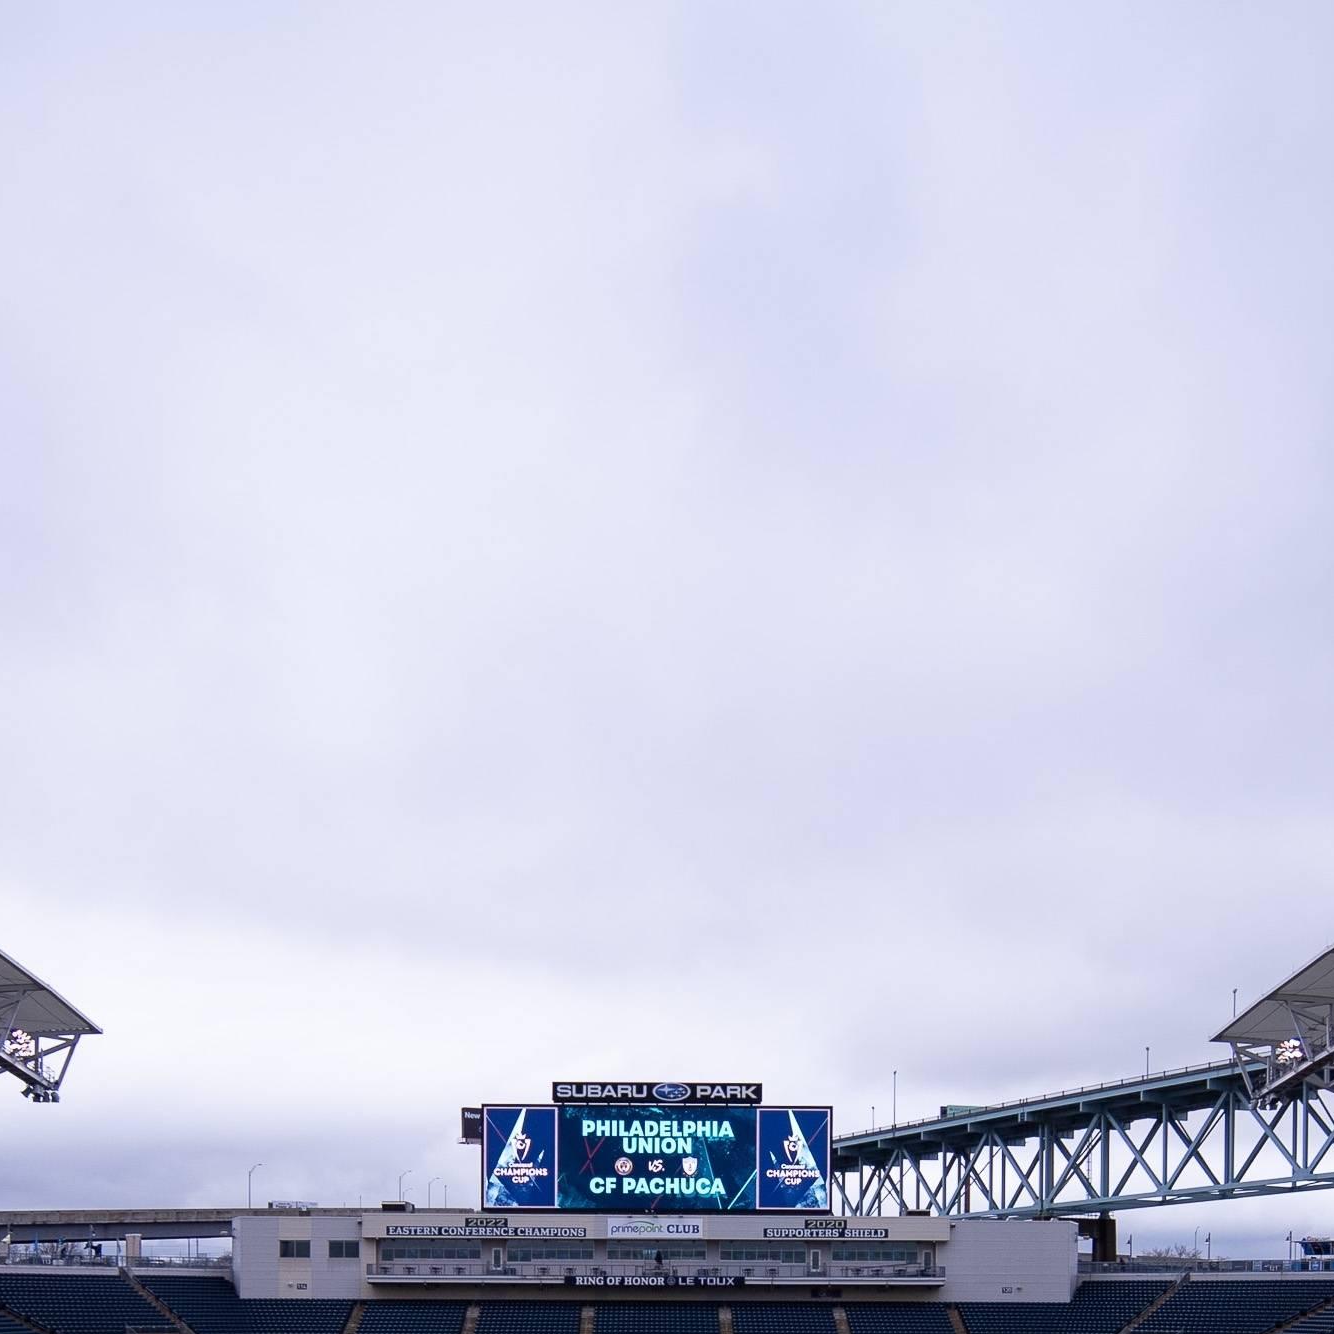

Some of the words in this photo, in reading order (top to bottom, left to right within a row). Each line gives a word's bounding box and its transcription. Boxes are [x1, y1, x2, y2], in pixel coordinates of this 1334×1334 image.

[556, 1084, 648, 1100] SUBARU
[696, 1085, 758, 1100] PARK
[464, 1112, 481, 1120] New
[582, 1119, 735, 1138] PHILADELPHIA
[622, 1137, 693, 1155] UNION
[493, 1168, 549, 1177] CHAMPIONS
[766, 1169, 821, 1178] CHAMPIONS
[511, 1176, 530, 1185] CUP
[784, 1178, 803, 1186] CUP
[589, 1177, 617, 1195] CF
[622, 1177, 727, 1196] PACHUCA
[467, 1218, 506, 1228] 2022
[808, 1219, 845, 1229] 2020
[388, 1225, 439, 1236] EASTERN
[441, 1226, 515, 1237] CONFERENCE
[517, 1227, 586, 1237] CHAMPIONS
[610, 1221, 665, 1237] primepoint
[666, 1224, 701, 1234] CLUB
[766, 1228, 843, 1238] SUPPORTERS'
[845, 1229, 886, 1239] SHIELD
[575, 1276, 605, 1286] RING
[607, 1276, 622, 1286] OF
[624, 1277, 665, 1286] HONOR
[678, 1277, 695, 1286] LE
[698, 1277, 735, 1286] TOUX
